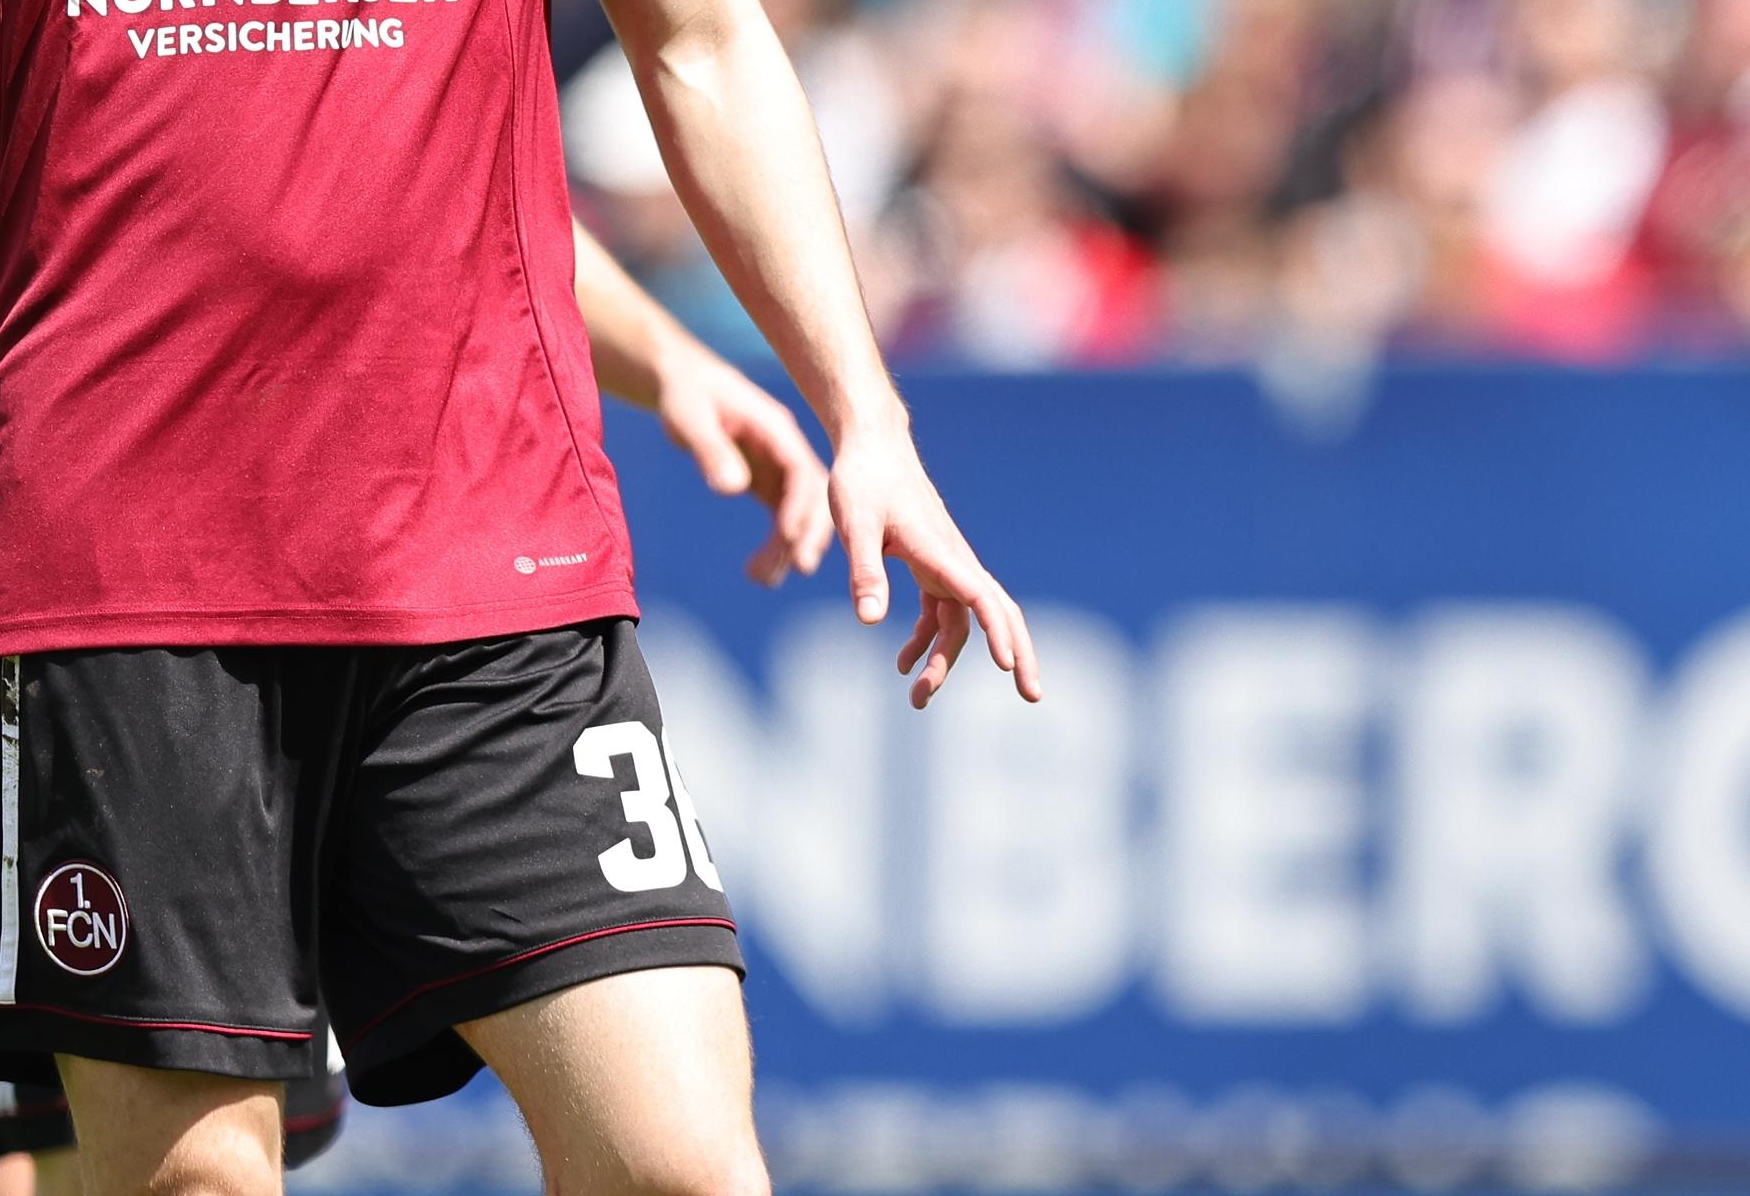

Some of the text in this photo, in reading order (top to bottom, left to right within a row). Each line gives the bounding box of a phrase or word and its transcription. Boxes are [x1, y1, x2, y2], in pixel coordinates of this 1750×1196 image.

[127, 18, 405, 59] VERSICHERUNG
[70, 872, 91, 909] 1.
[46, 908, 118, 950] FCN
